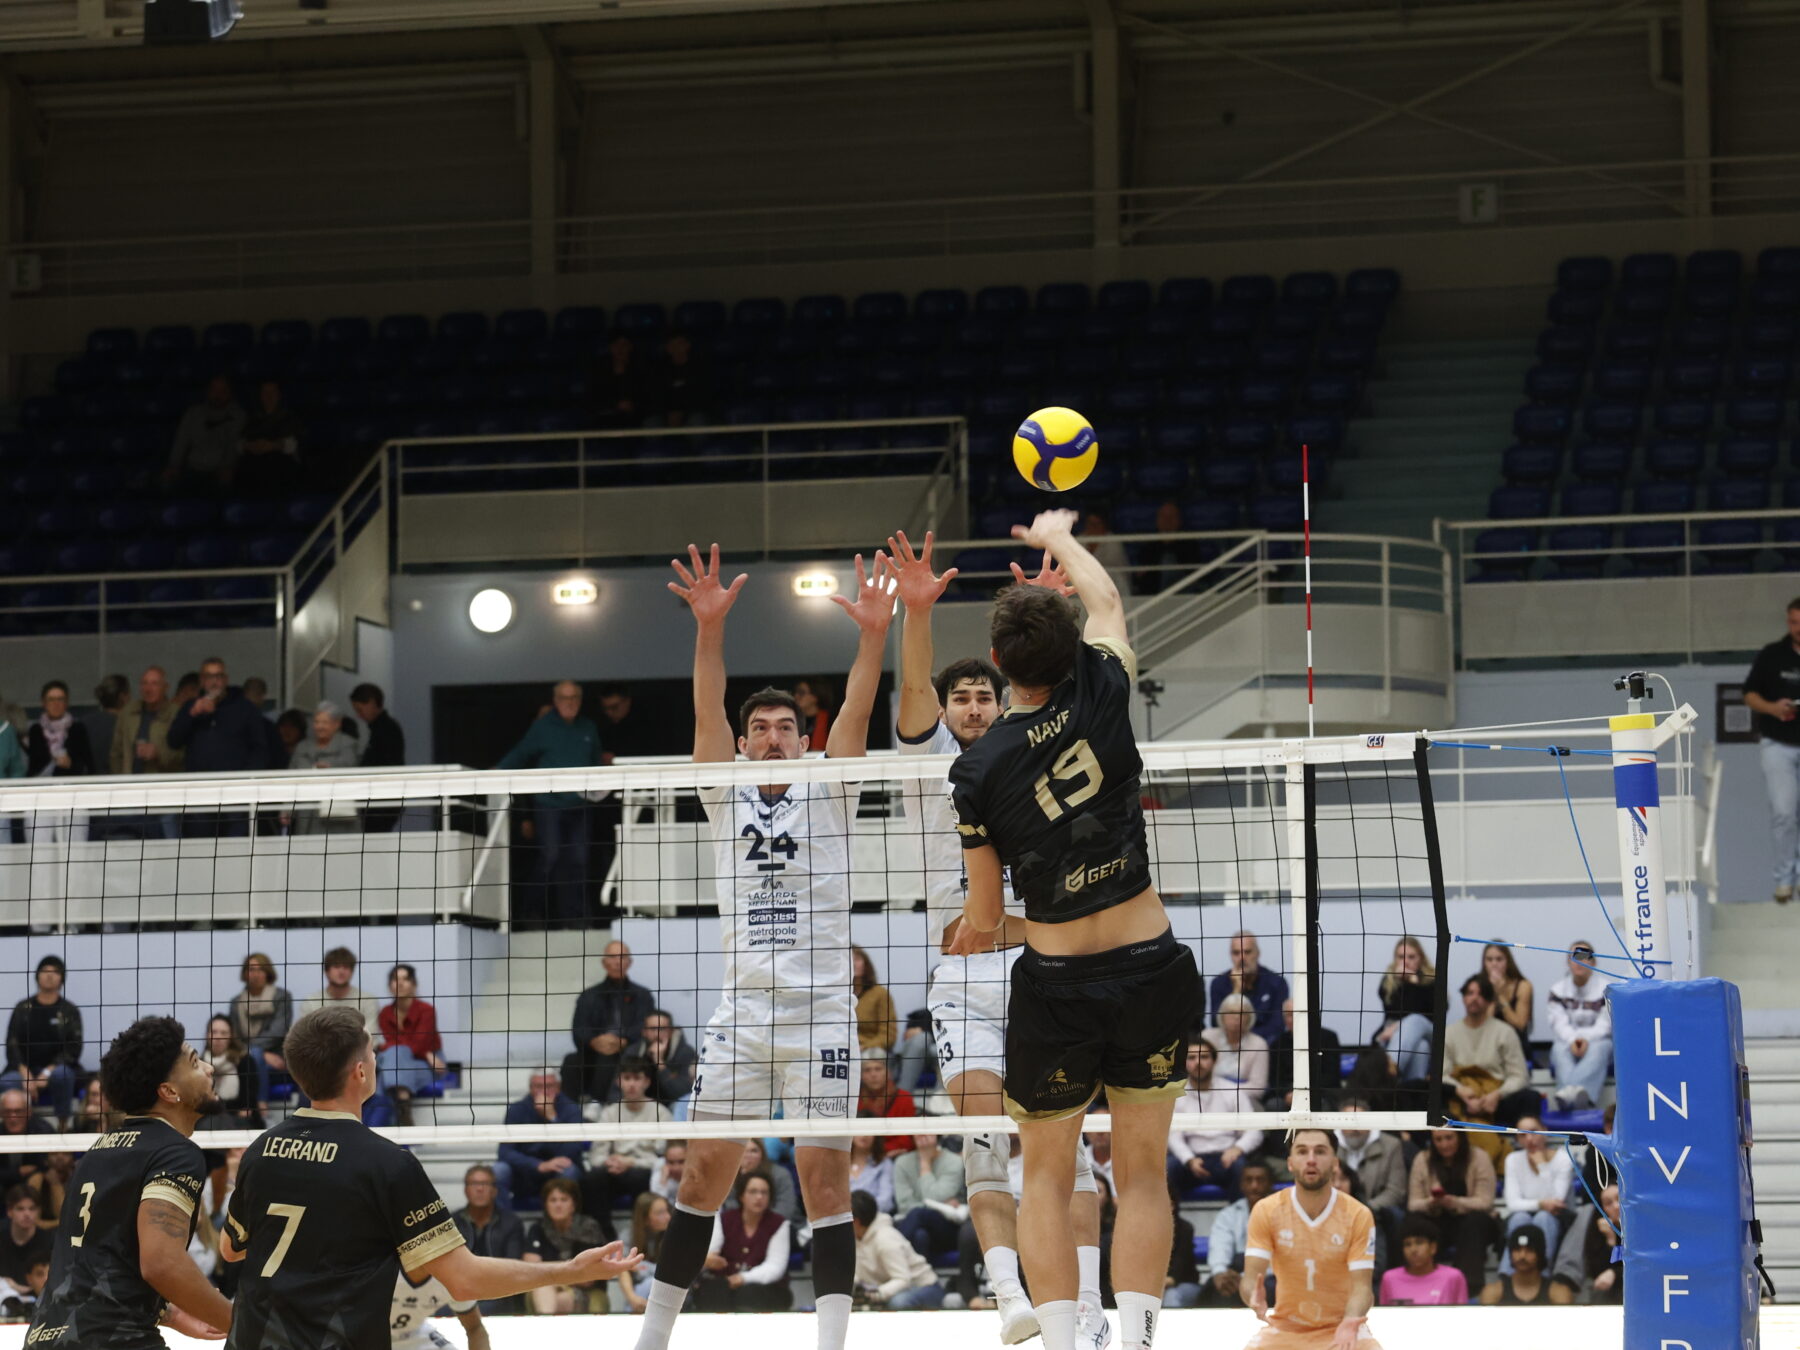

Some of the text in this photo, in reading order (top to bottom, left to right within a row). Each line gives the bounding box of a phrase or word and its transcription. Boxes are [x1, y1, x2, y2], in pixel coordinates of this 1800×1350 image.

[1034, 739, 1104, 822] 19
[741, 823, 798, 861] 24
[1088, 853, 1129, 884] GEFF
[1635, 865, 1653, 940] france
[262, 1137, 339, 1164] LEGRAND
[70, 1182, 96, 1248] 3
[261, 1203, 307, 1278] 7
[1304, 1259, 1316, 1291] 1
[38, 1325, 70, 1342] GEFF
[1141, 1309, 1153, 1341] CRAFT
